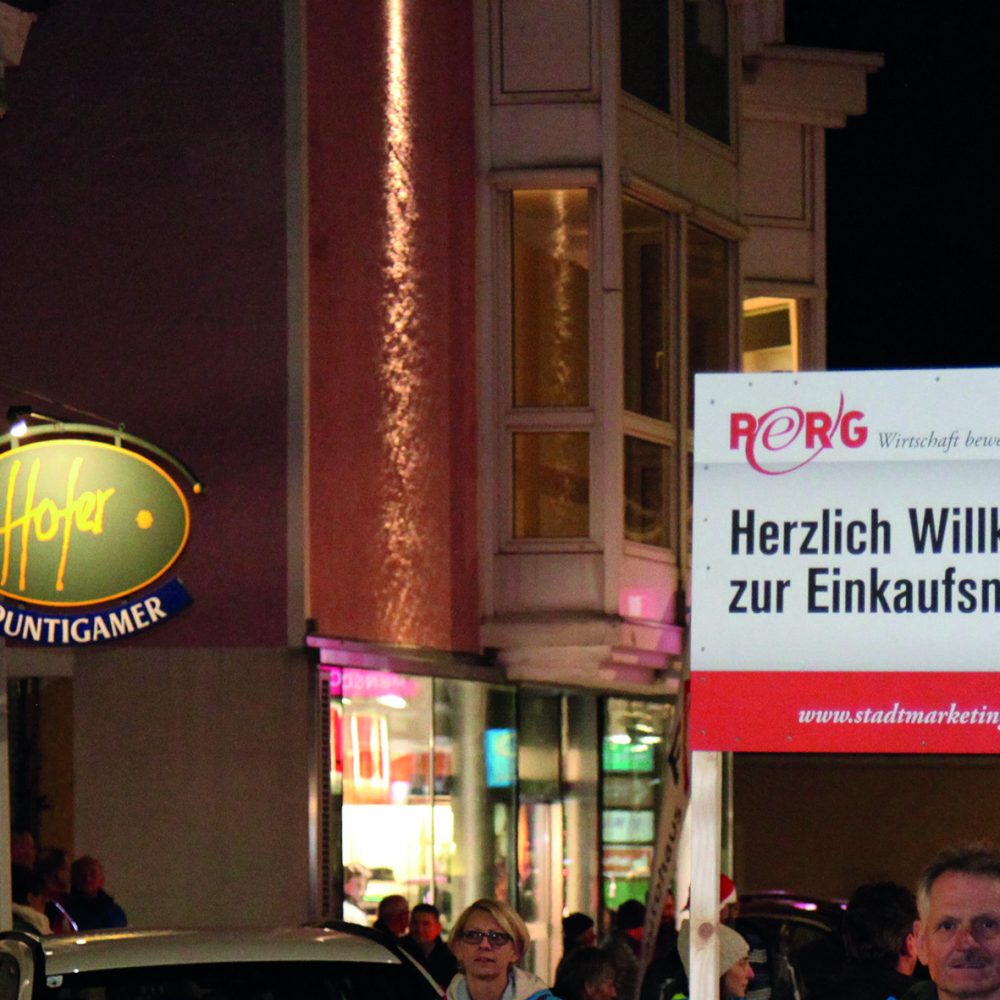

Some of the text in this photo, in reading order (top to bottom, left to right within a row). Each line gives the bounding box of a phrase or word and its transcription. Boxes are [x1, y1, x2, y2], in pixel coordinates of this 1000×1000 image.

[878, 430, 959, 453] Wirtschaft
[0, 456, 116, 592] Hofer
[731, 508, 892, 556] Herzlich
[728, 578, 791, 614] zur
